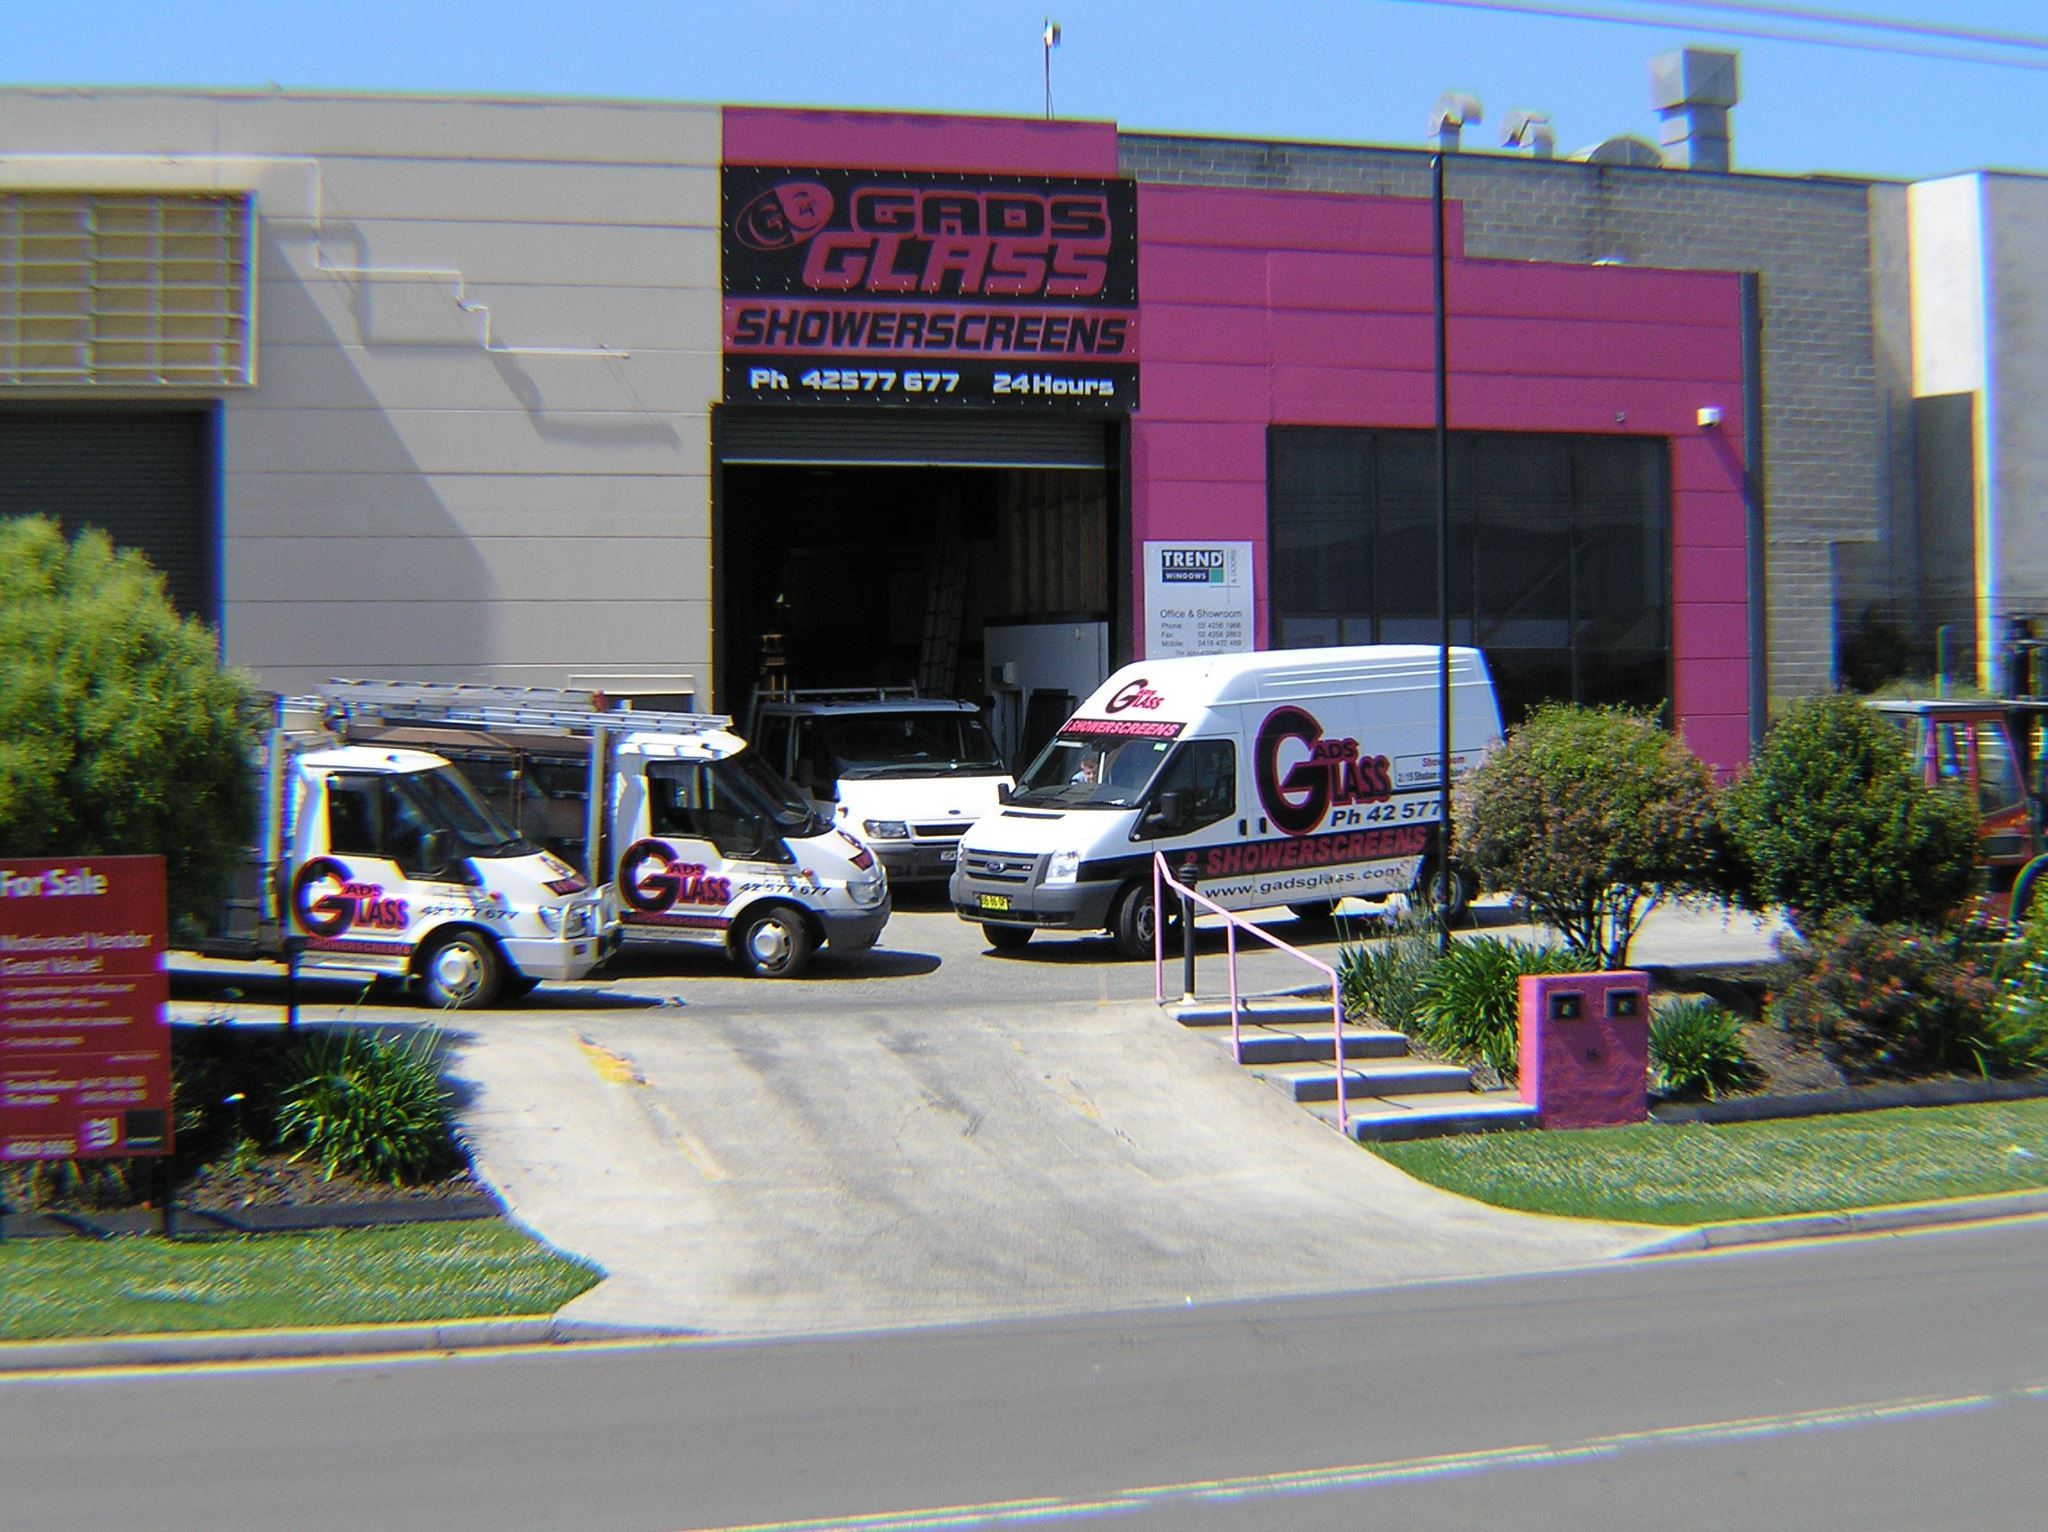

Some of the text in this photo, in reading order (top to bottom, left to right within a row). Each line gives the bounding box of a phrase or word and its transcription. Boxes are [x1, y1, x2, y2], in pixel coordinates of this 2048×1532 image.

[853, 189, 1110, 239] GADS
[802, 231, 1110, 296] GLASS
[733, 309, 1127, 354] SHOWERSCREENS
[749, 368, 789, 390] Ph
[802, 368, 896, 392] 42577
[904, 371, 960, 393] 677
[1163, 551, 1223, 567] TREND
[1165, 572, 1206, 580] WINDOWS
[1160, 609, 1242, 618] Office & Showroom
[1069, 721, 1180, 737] SHOWERSCREENS
[1330, 799, 1440, 826] Ph 42 577
[1205, 826, 1428, 876] SHOWERSCREENS
[0, 867, 108, 897] For Sale
